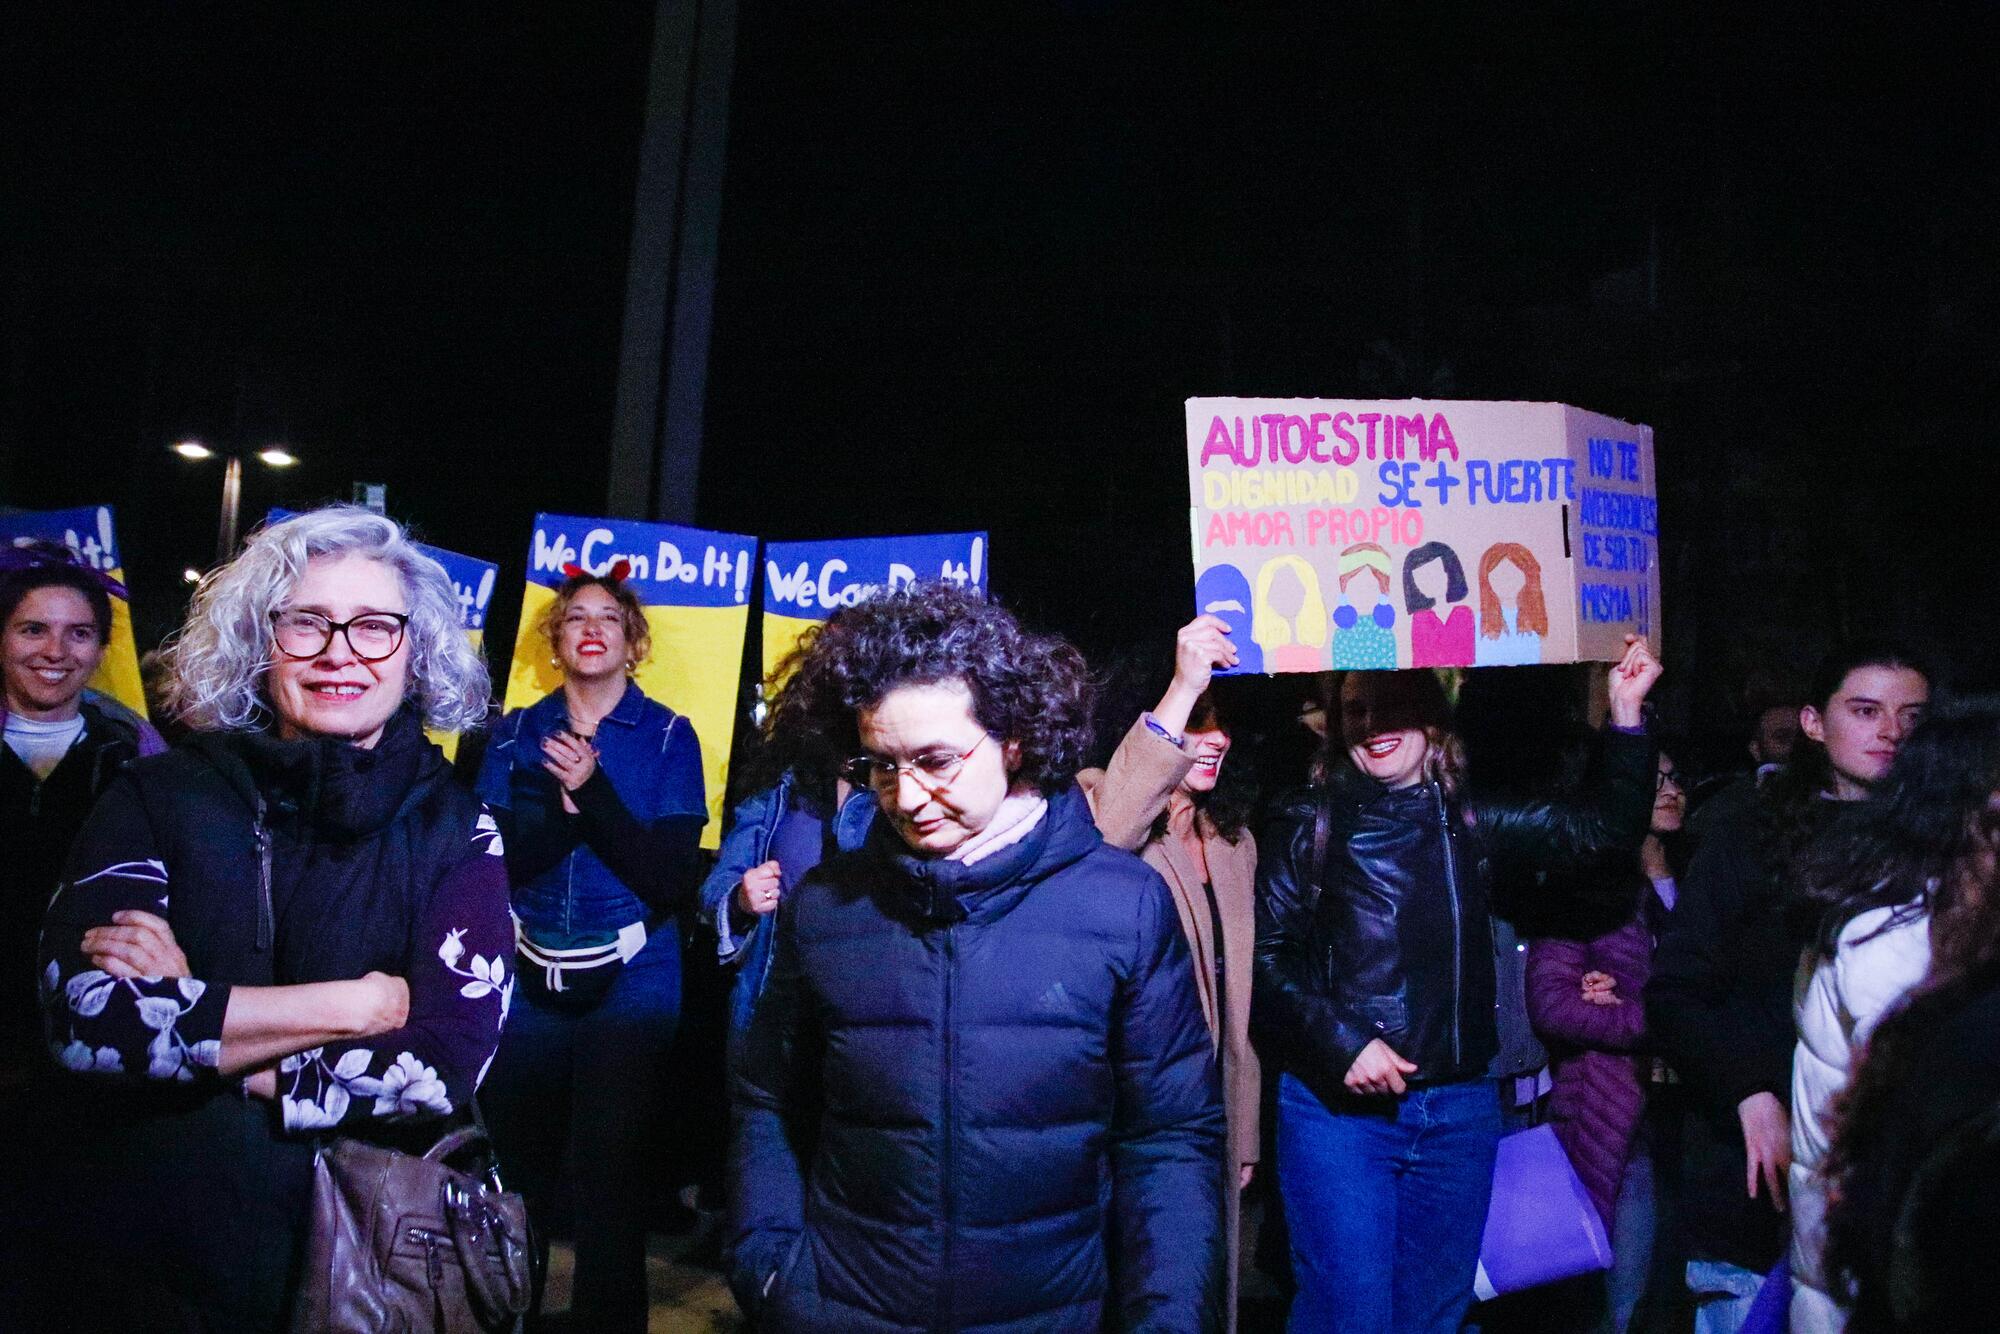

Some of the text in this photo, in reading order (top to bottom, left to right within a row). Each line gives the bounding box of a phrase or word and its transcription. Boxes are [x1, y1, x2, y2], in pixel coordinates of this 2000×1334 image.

[1201, 412, 1460, 468] AUTOESTIMA
[1587, 437, 1639, 482] NO TE
[1202, 468, 1360, 510] DIGNIDAD
[1378, 460, 1422, 508] SE
[1466, 458, 1577, 505] FUERTE
[1205, 507, 1424, 547] AMOR PROPIO
[534, 529, 576, 575] We
[655, 541, 698, 584] Do
[703, 545, 749, 603] It!
[1583, 532, 1603, 568] DE
[766, 560, 817, 607] We
[888, 563, 917, 602] D
[1581, 583, 1633, 624] MISMA
